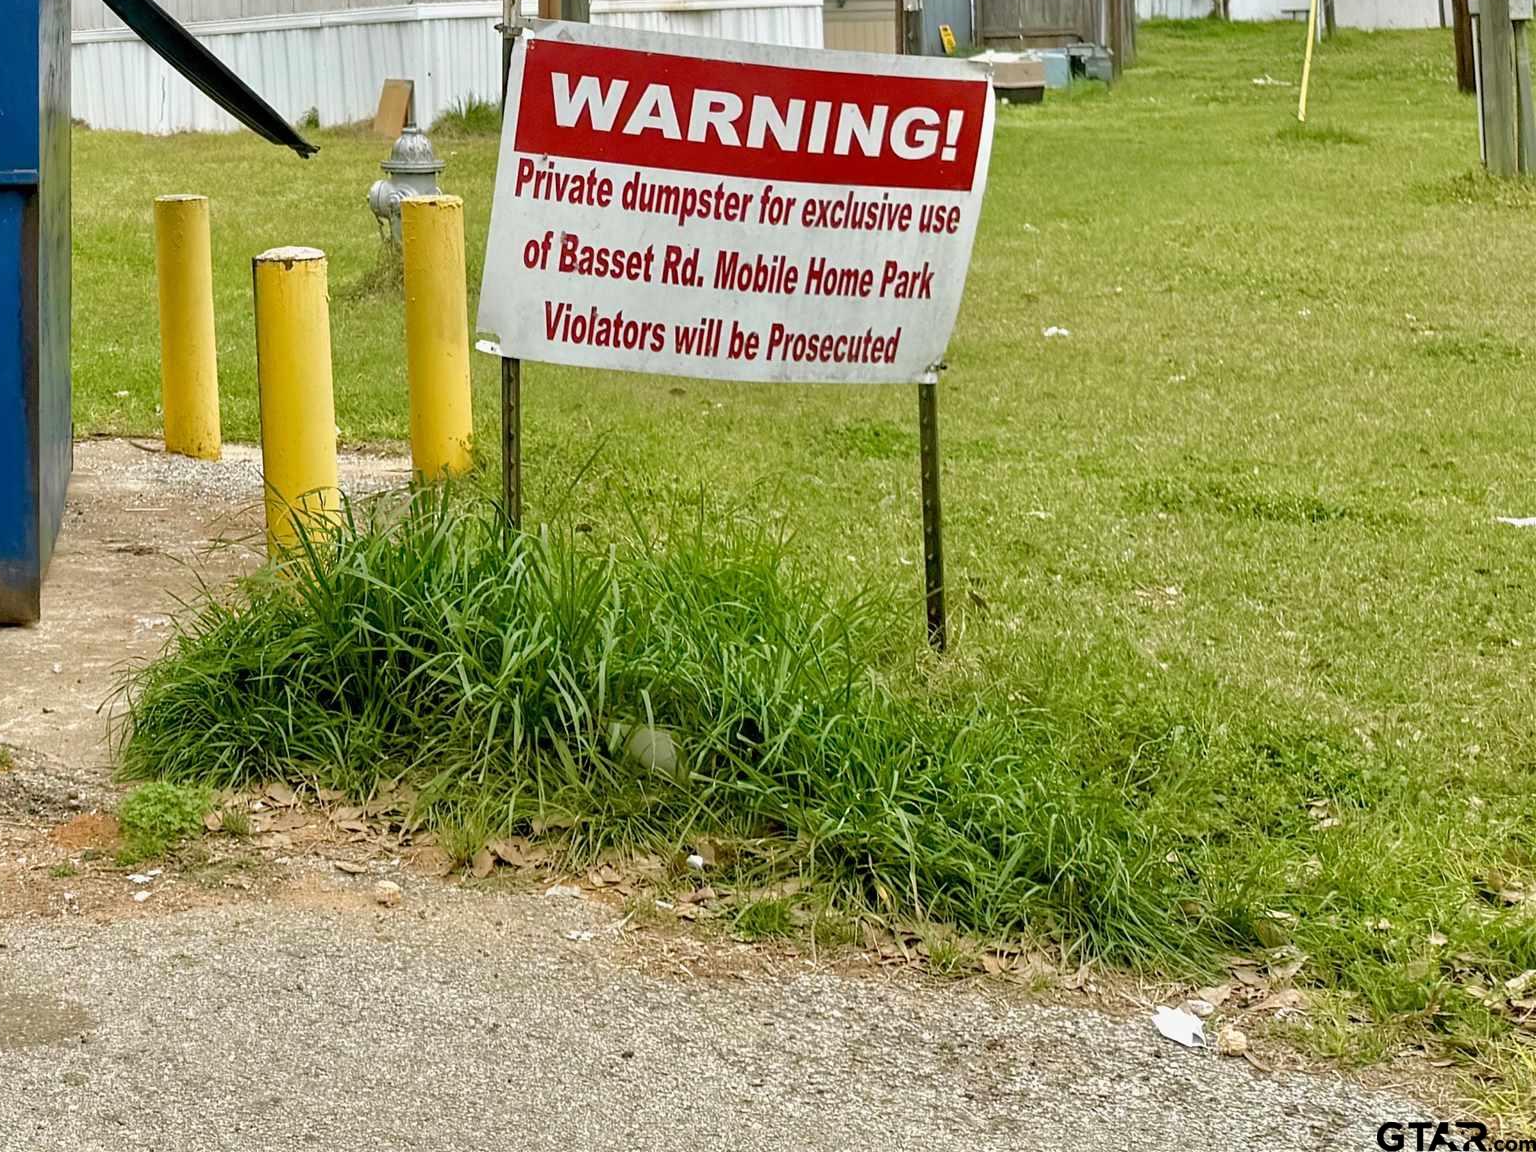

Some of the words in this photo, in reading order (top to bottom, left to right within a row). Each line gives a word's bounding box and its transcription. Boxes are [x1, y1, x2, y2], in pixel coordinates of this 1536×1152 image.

[550, 72, 965, 161] WARNING!
[514, 158, 613, 207] Private
[621, 172, 753, 226] dumpster
[759, 185, 796, 226] for
[801, 191, 912, 234] exclusive
[918, 203, 961, 235] use
[523, 231, 554, 271] of
[558, 233, 655, 283] Basset
[661, 245, 704, 288] Rd.
[713, 251, 798, 297] Mobile
[805, 256, 873, 298] Home
[879, 260, 935, 301] Park
[543, 301, 665, 352] Violators
[675, 318, 723, 359] will
[729, 321, 760, 361] be
[766, 323, 902, 365] Prosecuted
